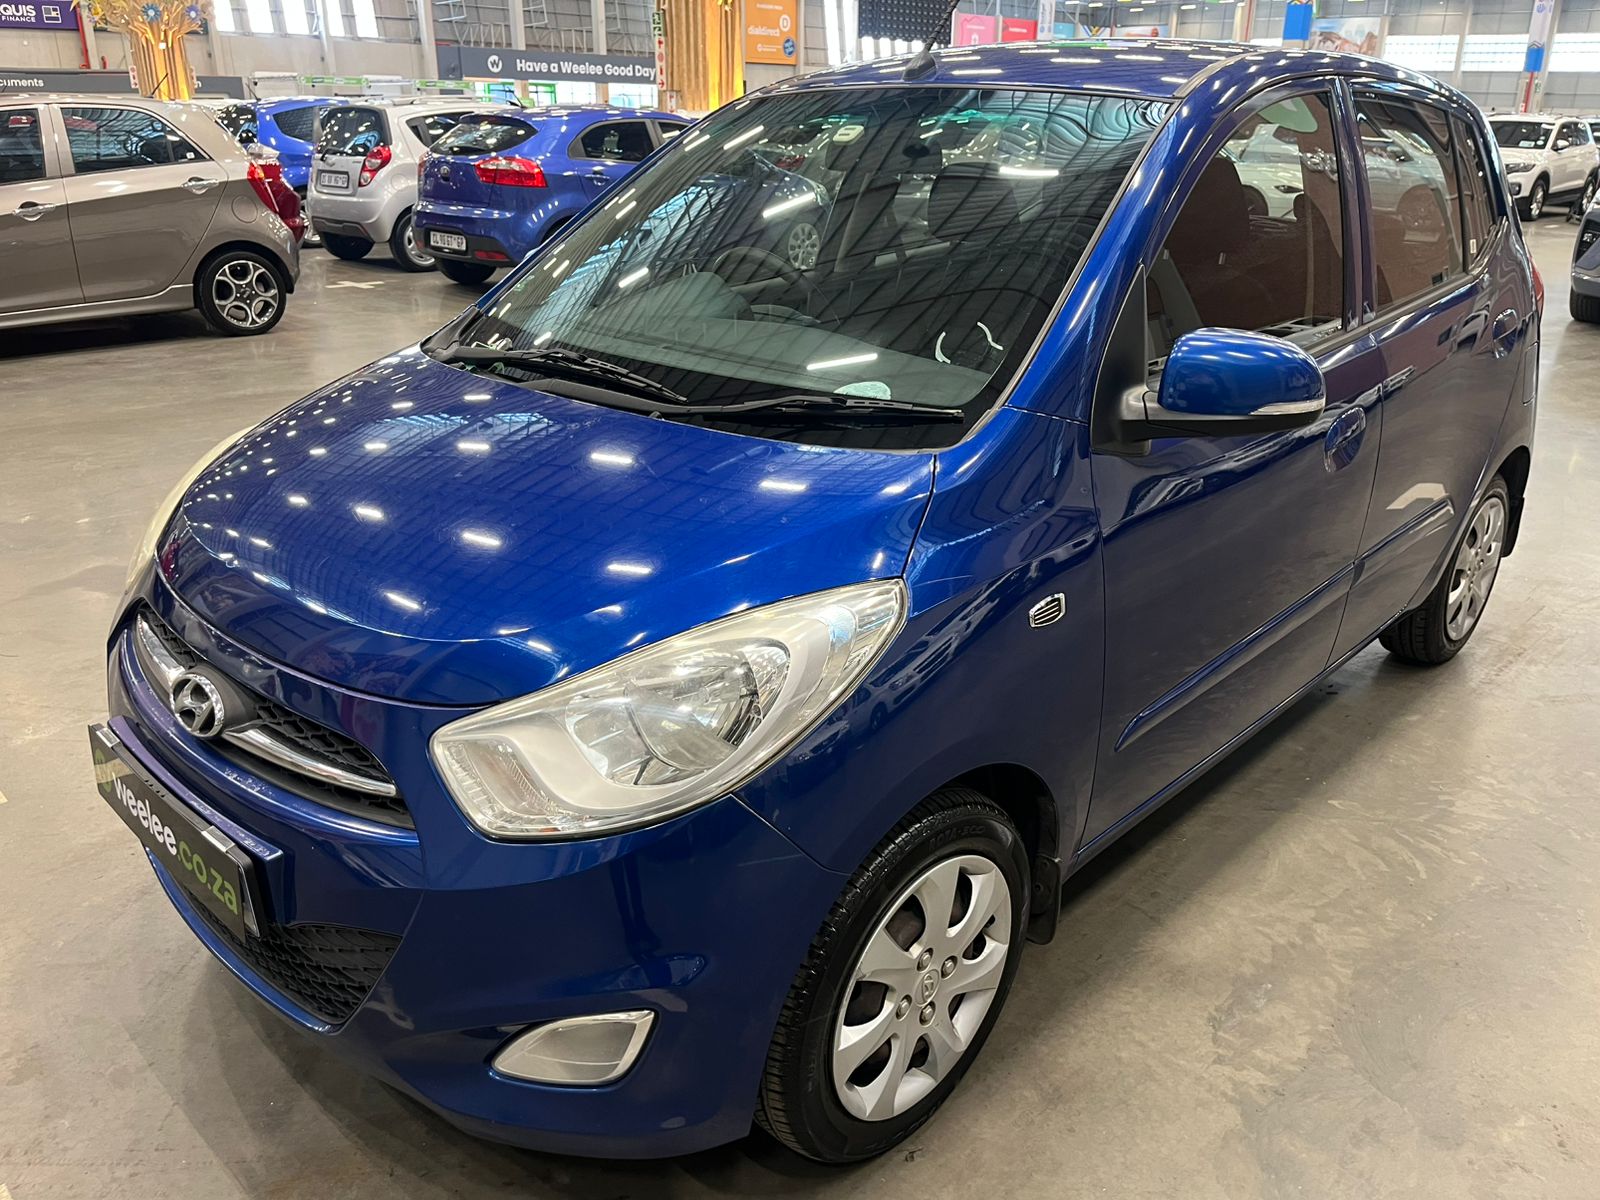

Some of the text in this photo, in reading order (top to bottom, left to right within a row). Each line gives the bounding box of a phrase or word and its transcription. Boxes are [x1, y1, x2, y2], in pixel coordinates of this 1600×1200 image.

[0, 4, 36, 16] QUIS
[1, 15, 36, 23] FINANCE
[516, 58, 548, 73] Have
[550, 62, 558, 74] a
[560, 61, 603, 75] Weelee
[604, 63, 634, 77] Good
[635, 65, 657, 80] Day
